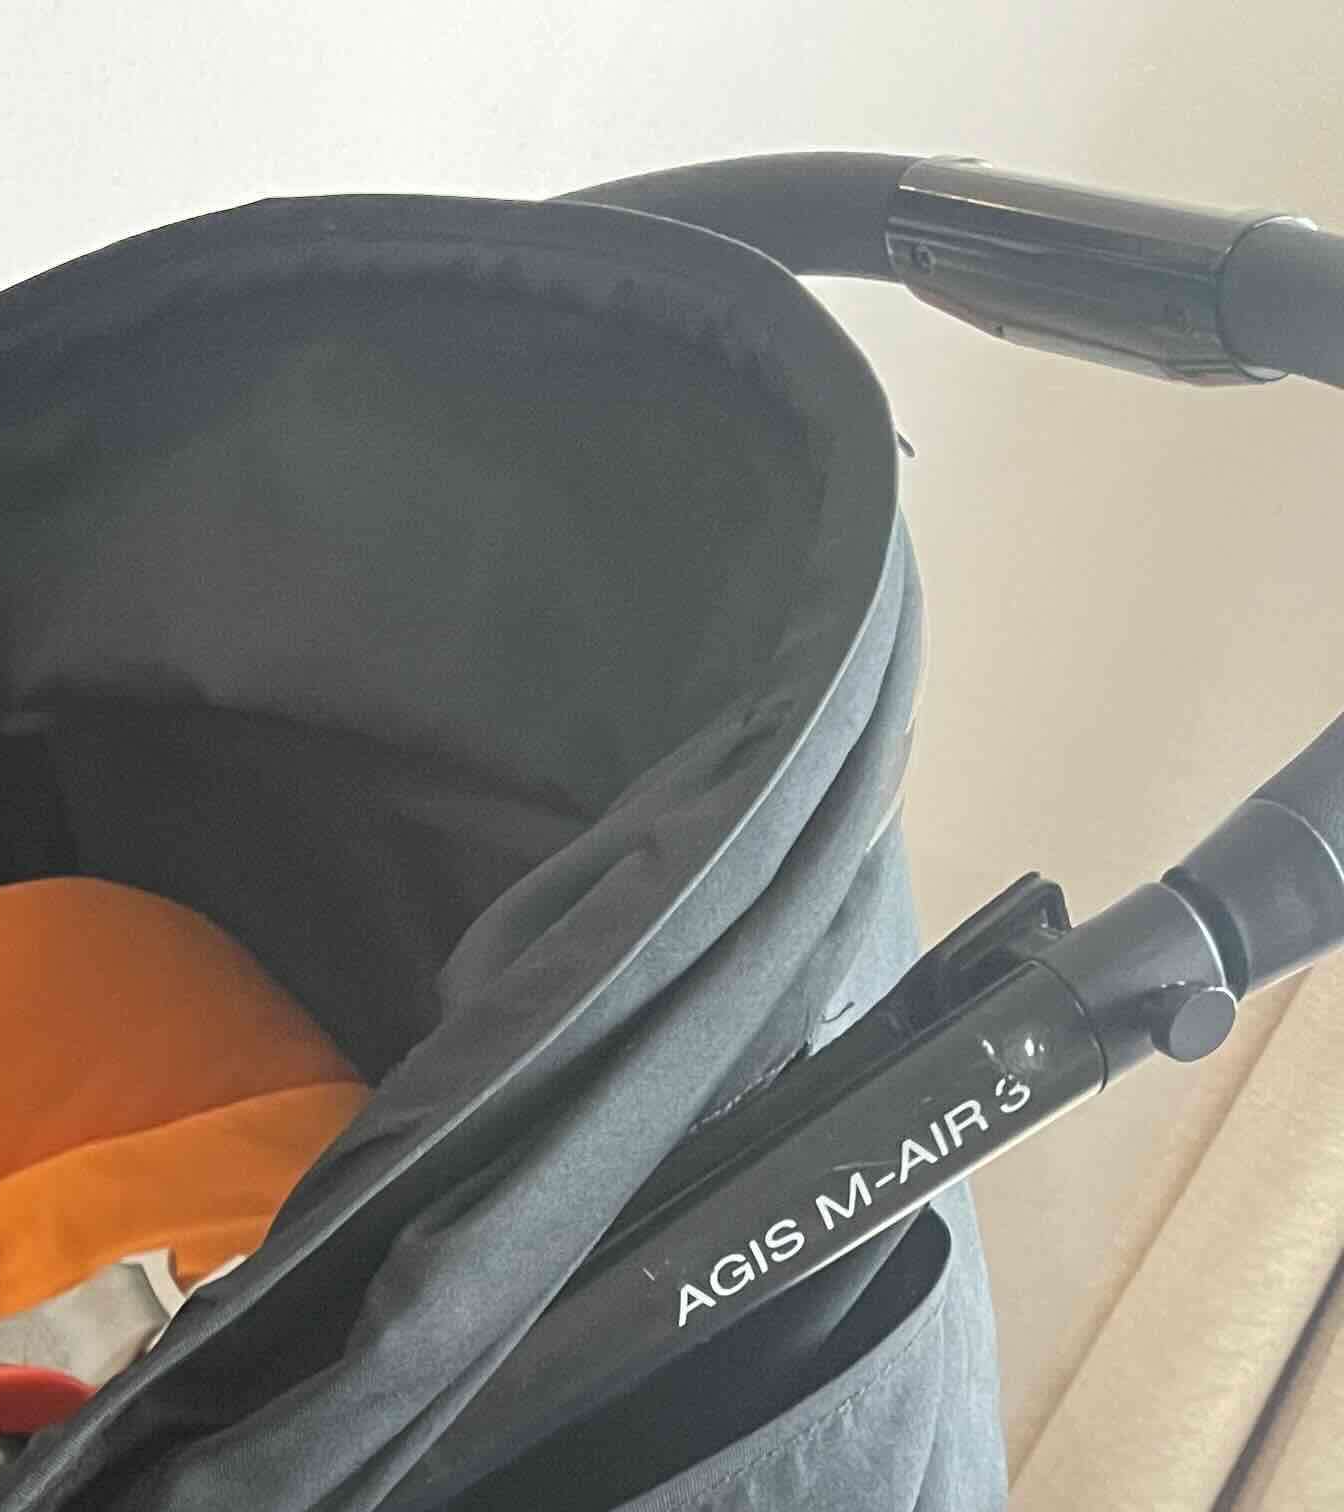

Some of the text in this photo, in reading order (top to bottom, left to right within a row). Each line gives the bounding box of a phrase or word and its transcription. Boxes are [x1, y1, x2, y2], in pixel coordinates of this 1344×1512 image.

[677, 1074, 1032, 1328] AGIS M-AIR 3
